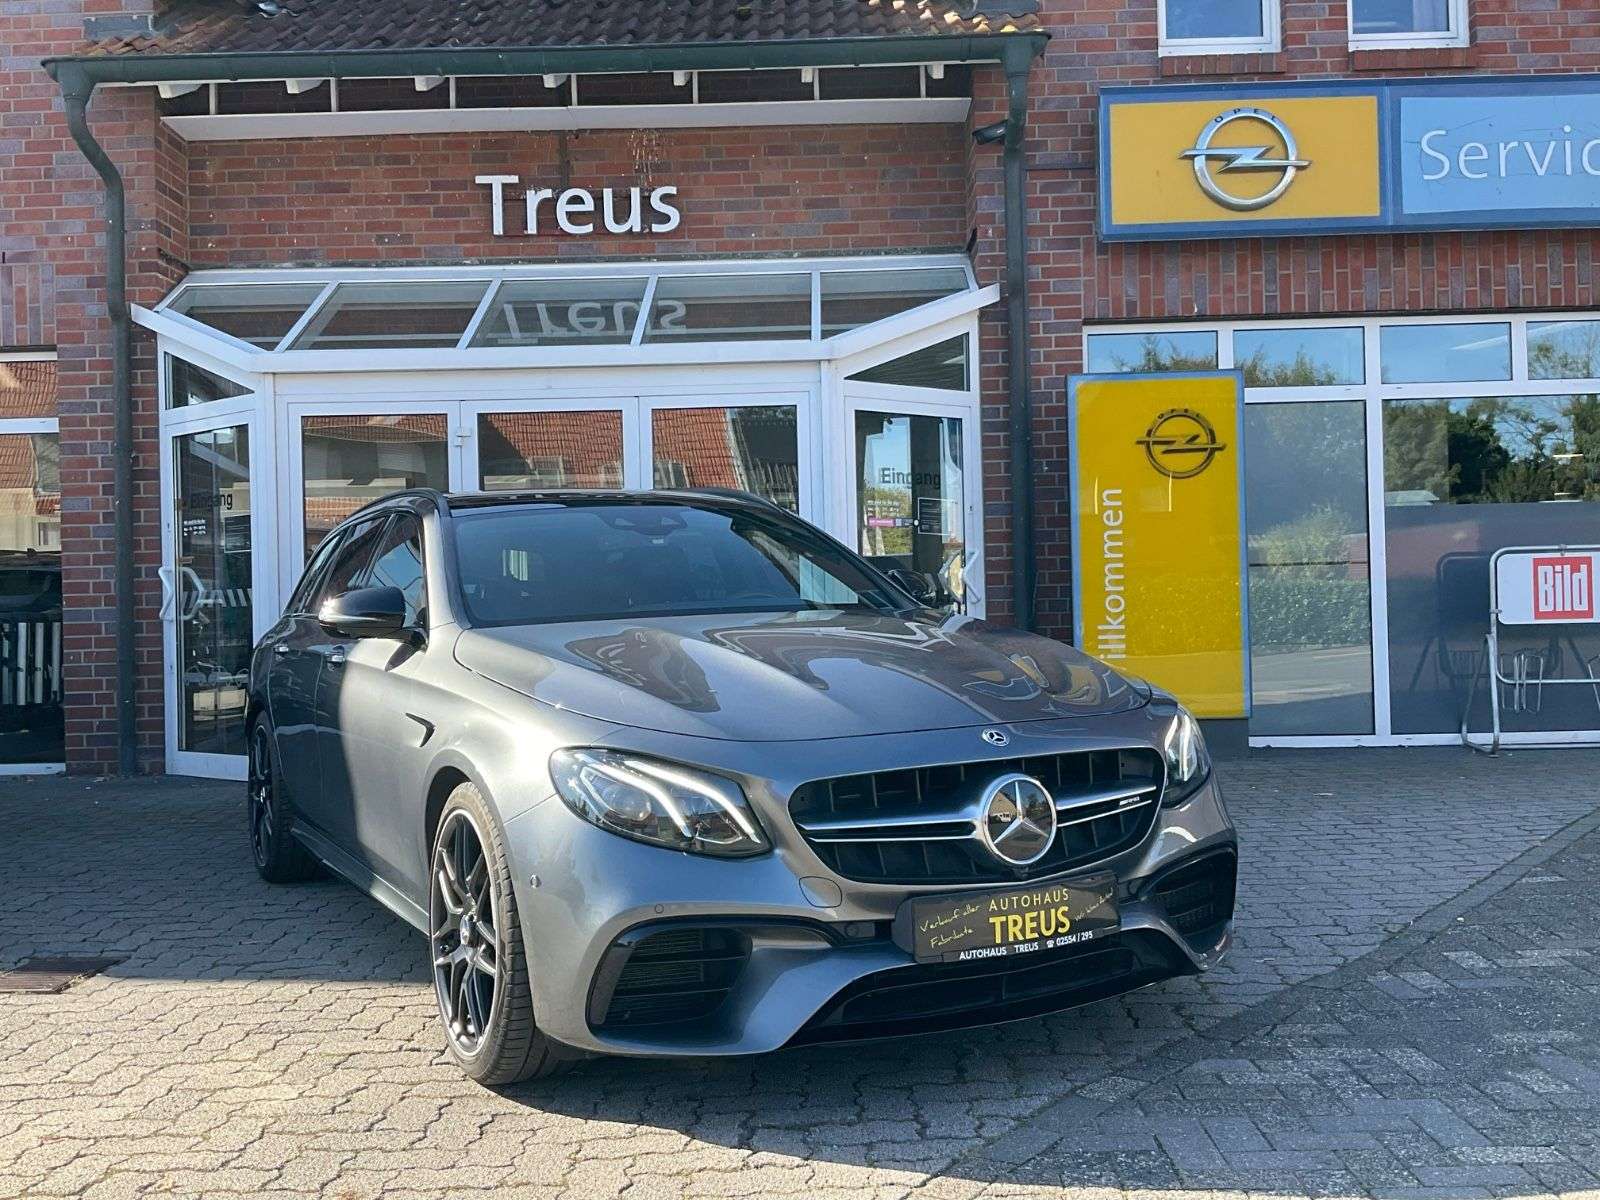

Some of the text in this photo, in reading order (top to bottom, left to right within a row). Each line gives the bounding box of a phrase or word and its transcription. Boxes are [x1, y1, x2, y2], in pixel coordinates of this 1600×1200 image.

[1214, 107, 1277, 123] OPEL
[1420, 125, 1600, 180] Servic
[475, 175, 681, 235] Treus
[880, 467, 941, 490] Eingang
[1097, 488, 1127, 660] illkommen
[1537, 564, 1589, 612] Bild
[988, 887, 1070, 912] AUTOHAUS
[988, 905, 1071, 945] TREUS
[959, 946, 1008, 961] AUTOHAUS
[1014, 941, 1039, 953] TREUS
